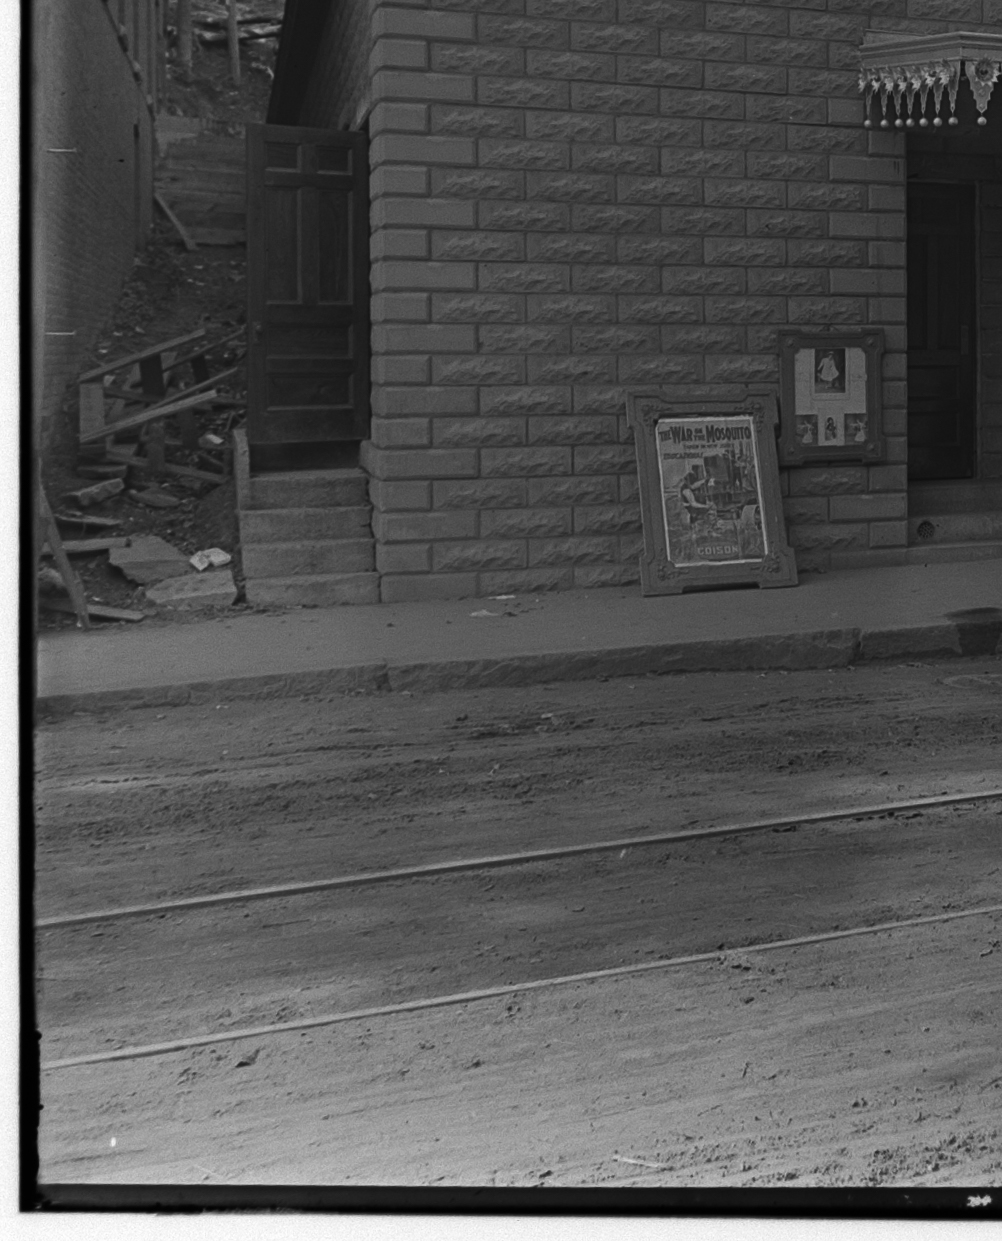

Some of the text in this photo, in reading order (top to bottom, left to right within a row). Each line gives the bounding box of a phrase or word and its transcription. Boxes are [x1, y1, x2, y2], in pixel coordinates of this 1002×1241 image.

[658, 429, 672, 442] THE
[670, 425, 693, 444] WAR
[705, 424, 752, 443] MOSQUITO
[697, 545, 740, 556] EDISON
